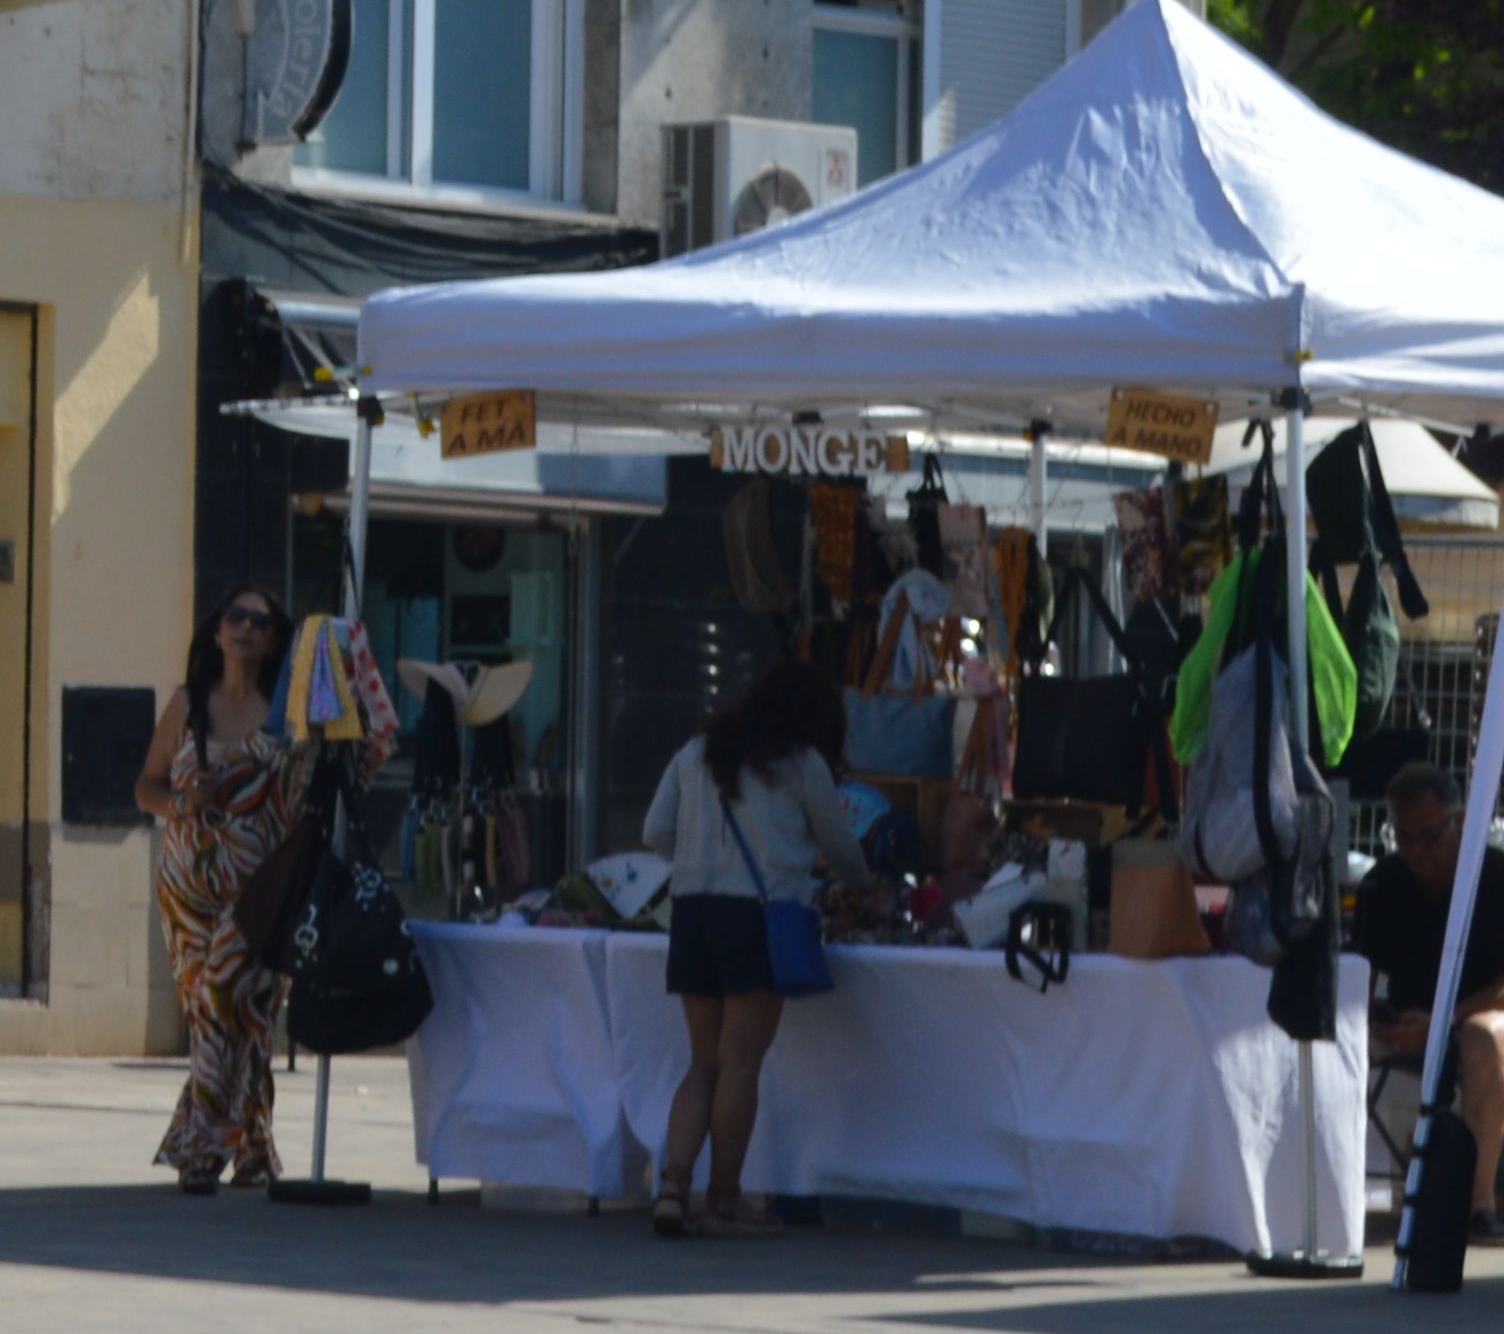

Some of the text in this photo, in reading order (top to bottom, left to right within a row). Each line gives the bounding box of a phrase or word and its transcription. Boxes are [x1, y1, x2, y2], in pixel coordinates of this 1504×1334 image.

[459, 397, 510, 424] FET
[1125, 399, 1196, 428] HECHO
[445, 432, 467, 455] A
[720, 424, 887, 476] MONGE
[1111, 424, 1202, 457] A MANO
